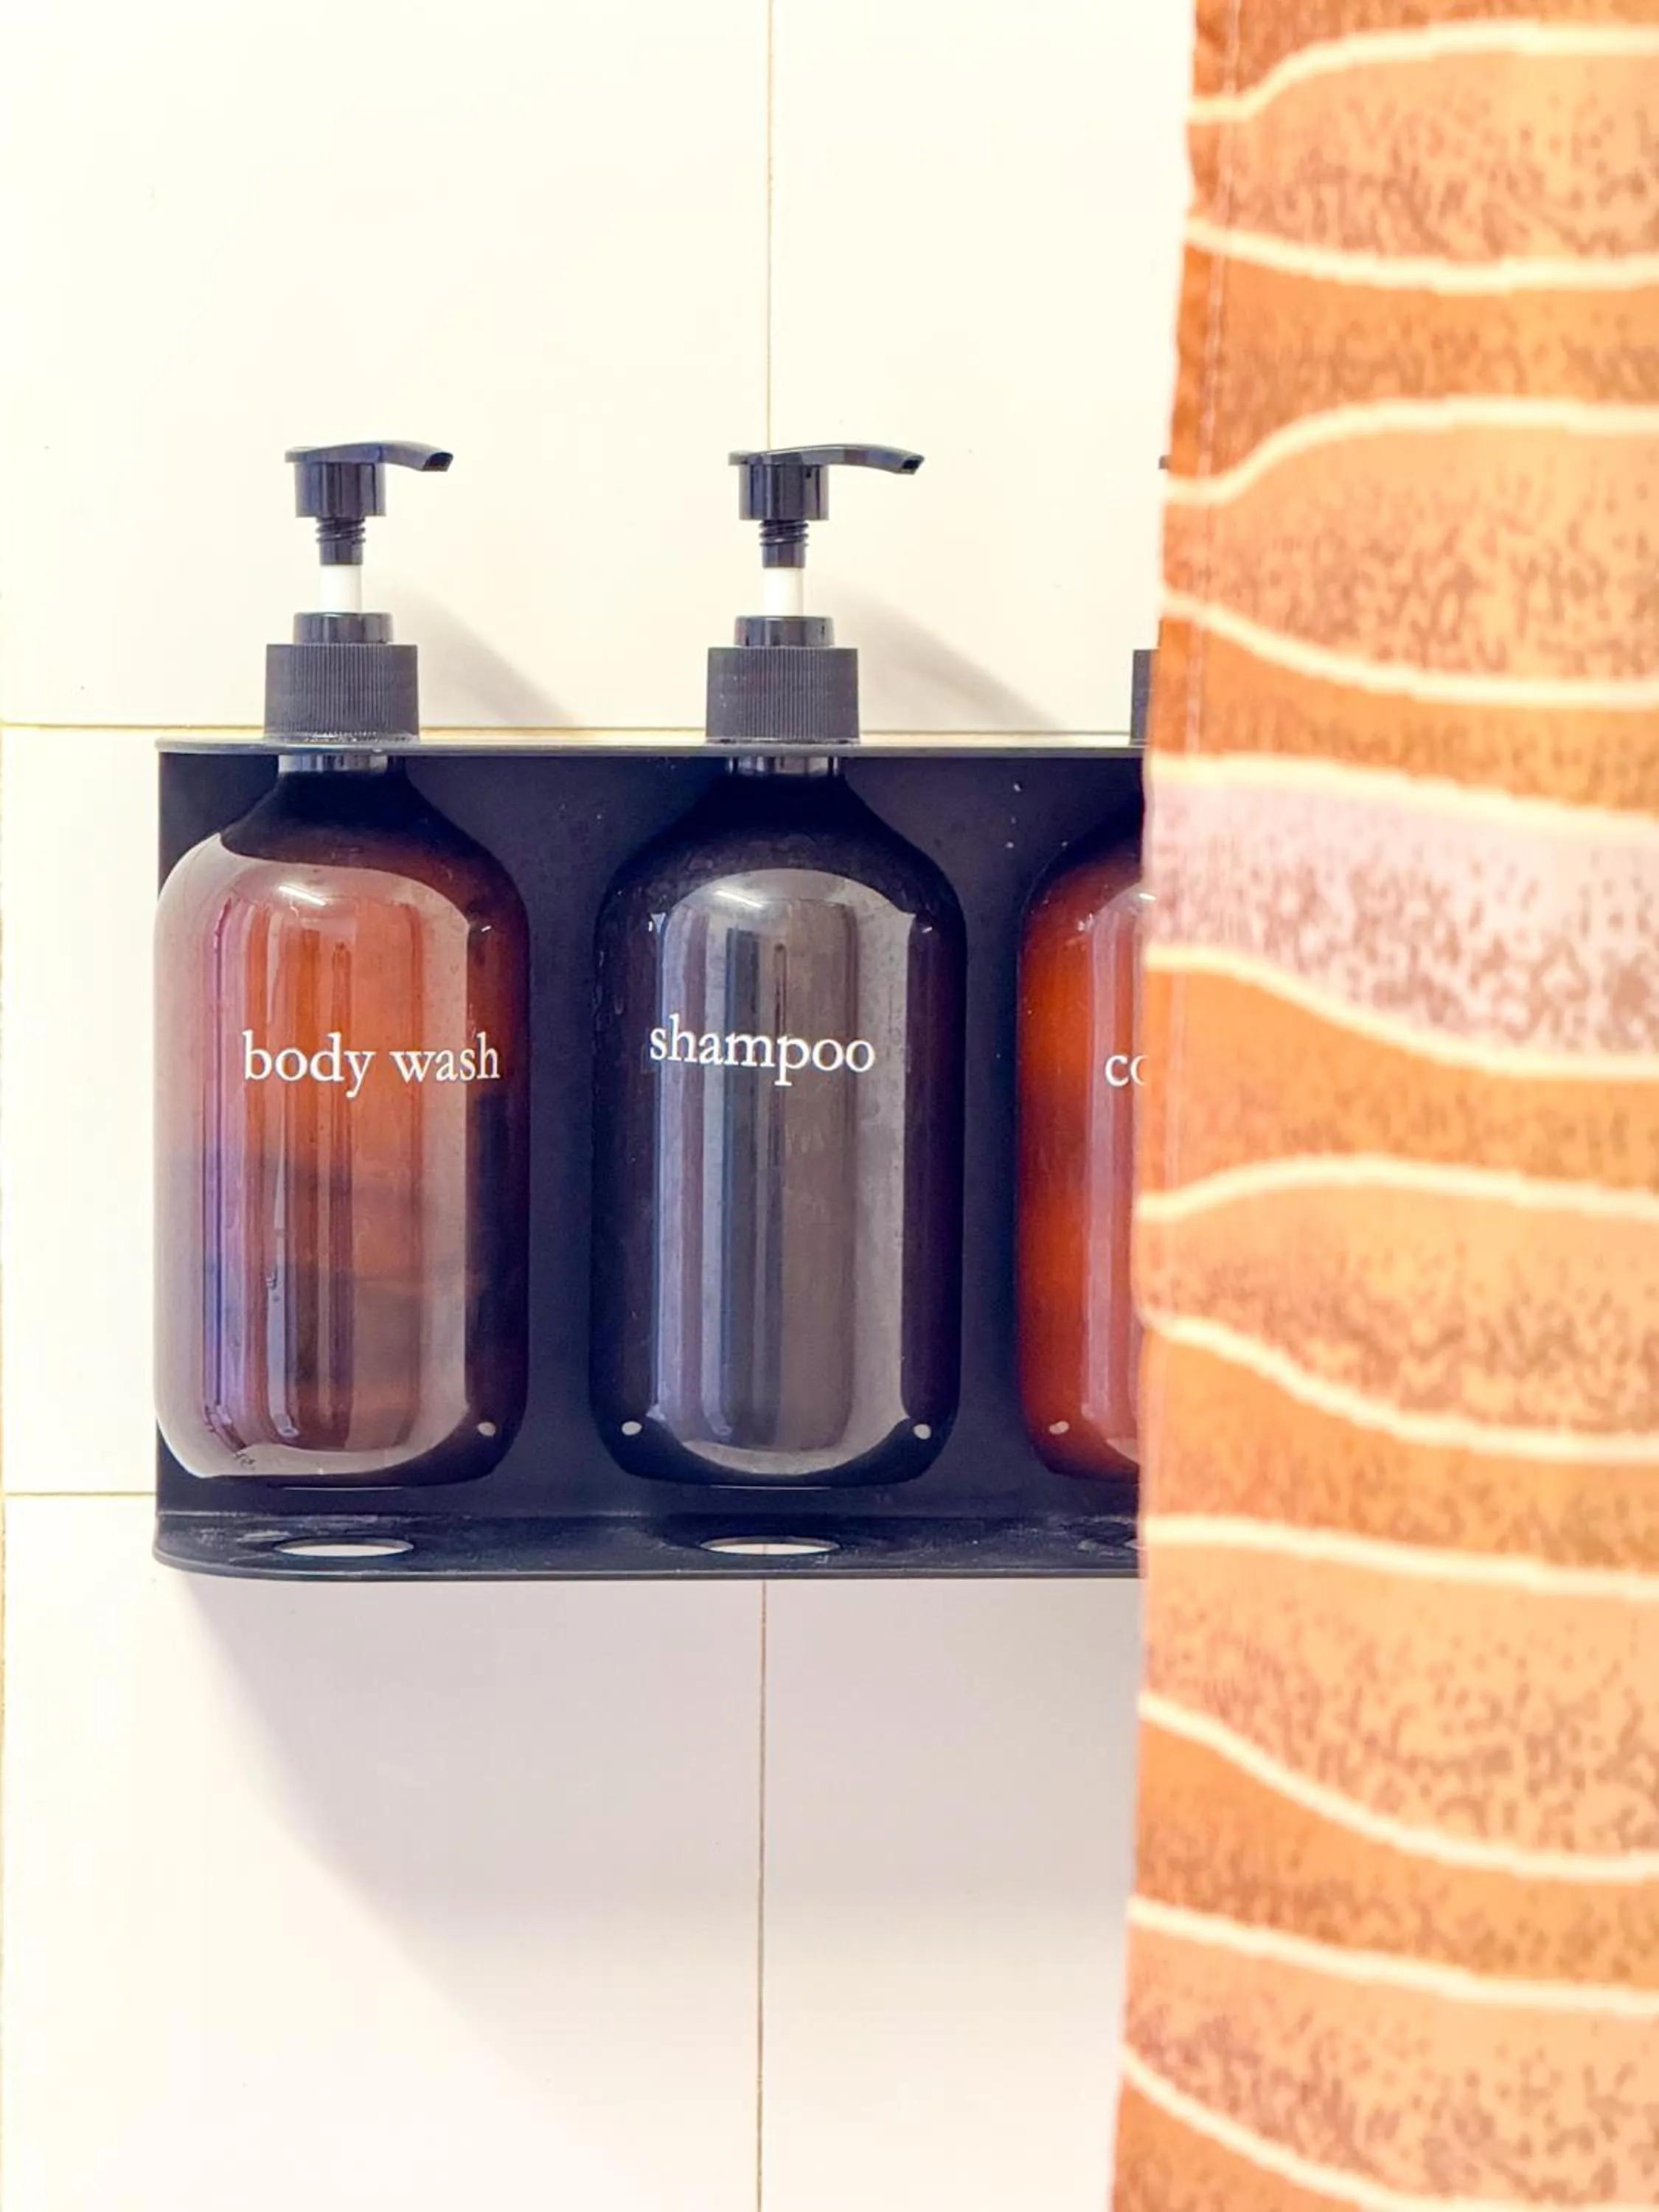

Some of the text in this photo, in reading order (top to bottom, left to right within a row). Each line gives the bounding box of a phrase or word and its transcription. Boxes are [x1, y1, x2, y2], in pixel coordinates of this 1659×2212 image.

[241, 1029, 501, 1098] body wash
[650, 1012, 875, 1086] shampoo
